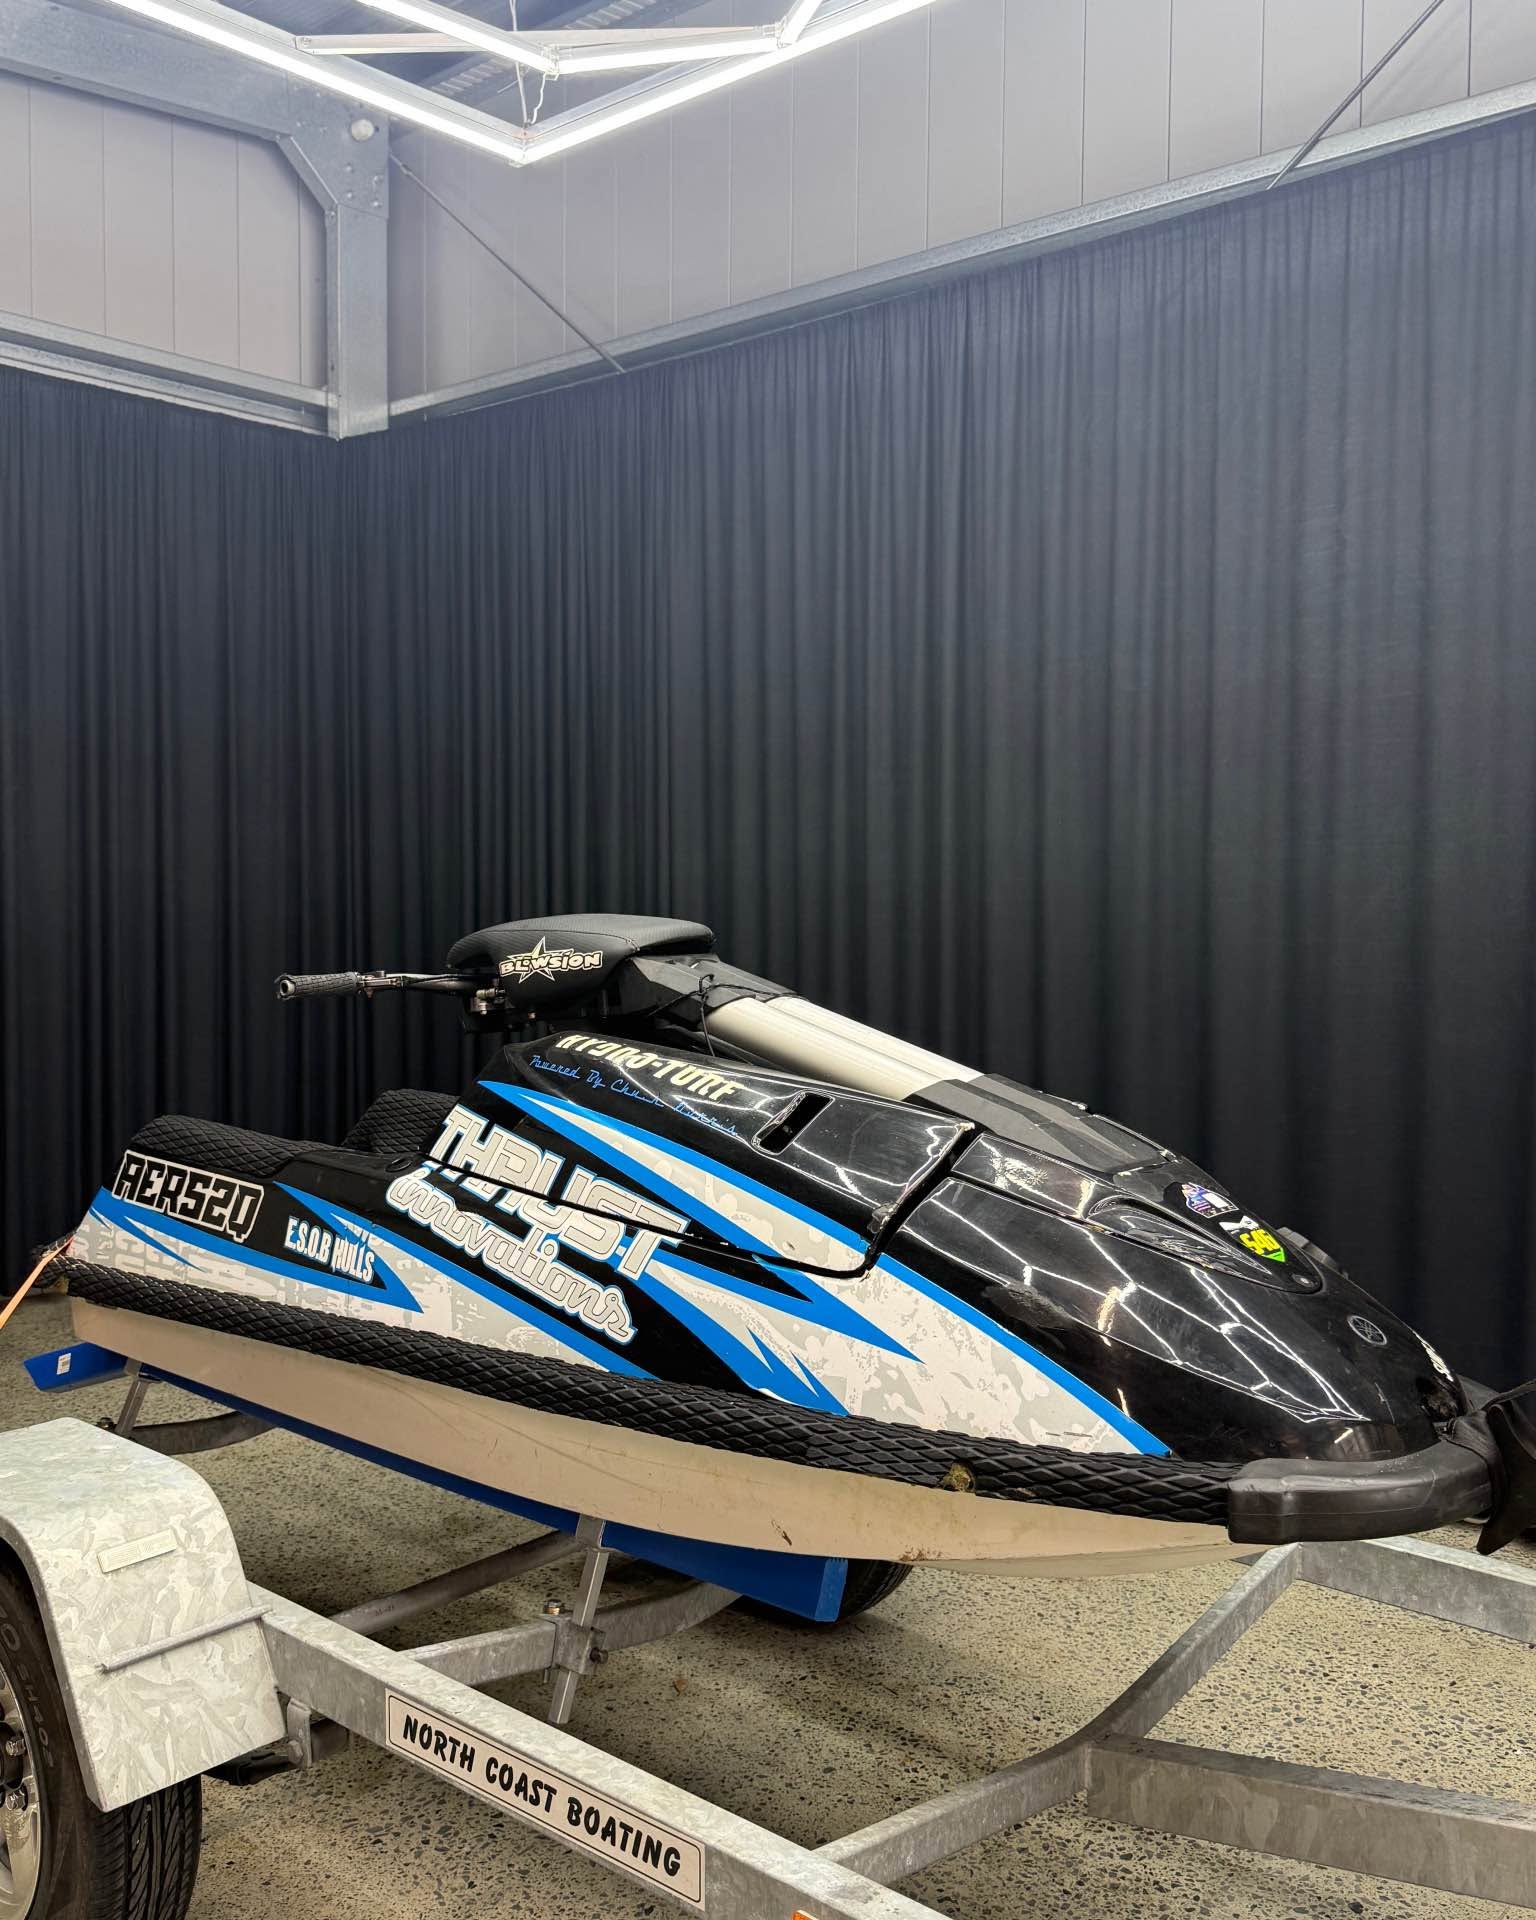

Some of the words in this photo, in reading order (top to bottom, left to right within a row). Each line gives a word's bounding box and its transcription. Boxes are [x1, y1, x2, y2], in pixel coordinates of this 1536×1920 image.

[529, 1055, 581, 1079] Powered
[586, 1069, 606, 1088] By
[555, 1034, 743, 1101] HYDRO-TURF
[421, 1104, 691, 1281] THRUST
[330, 1234, 376, 1284] HULLS
[403, 1714, 476, 1773] NORTH
[485, 1756, 558, 1813] COAST
[566, 1796, 682, 1878] BOATING
